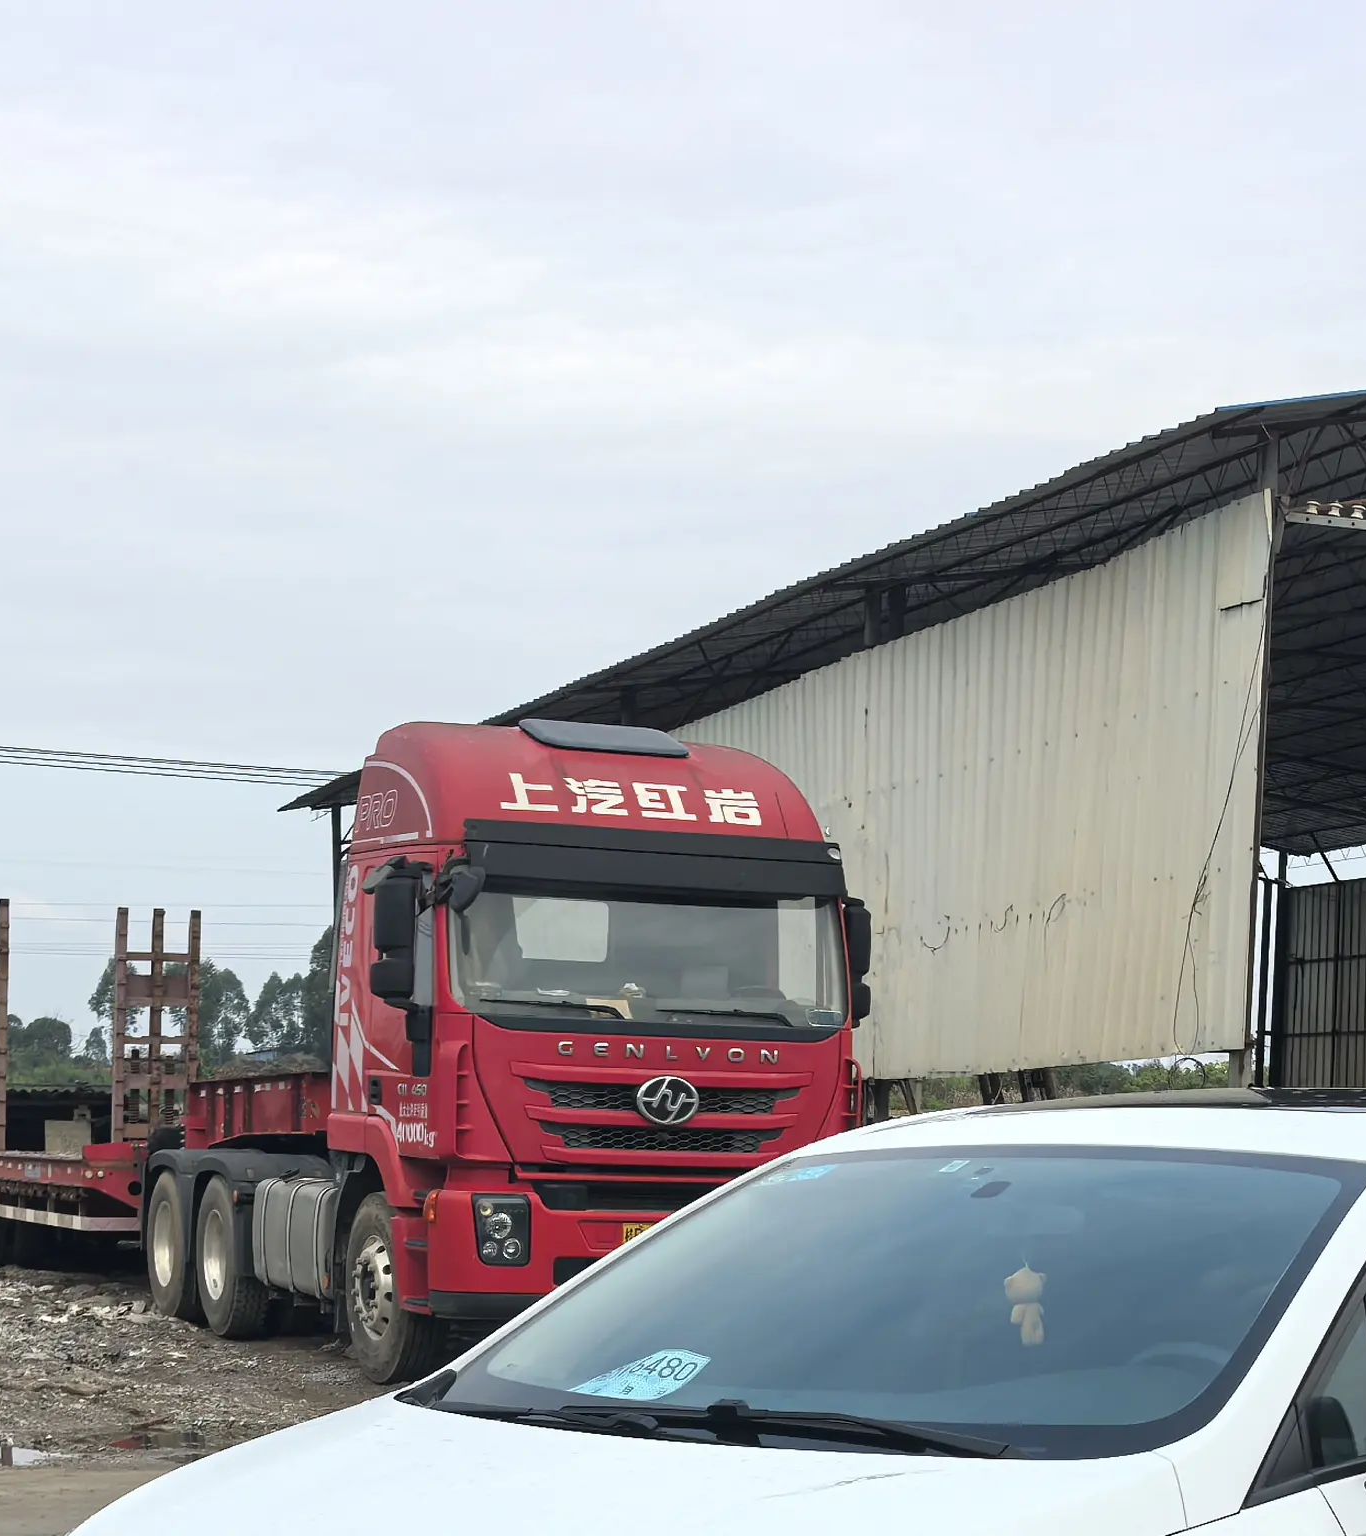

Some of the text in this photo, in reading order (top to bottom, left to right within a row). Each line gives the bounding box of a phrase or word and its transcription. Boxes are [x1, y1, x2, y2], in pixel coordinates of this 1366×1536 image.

[354, 789, 398, 833] PRO
[500, 772, 762, 826] 上汽红岩
[334, 864, 359, 1026] IVECO
